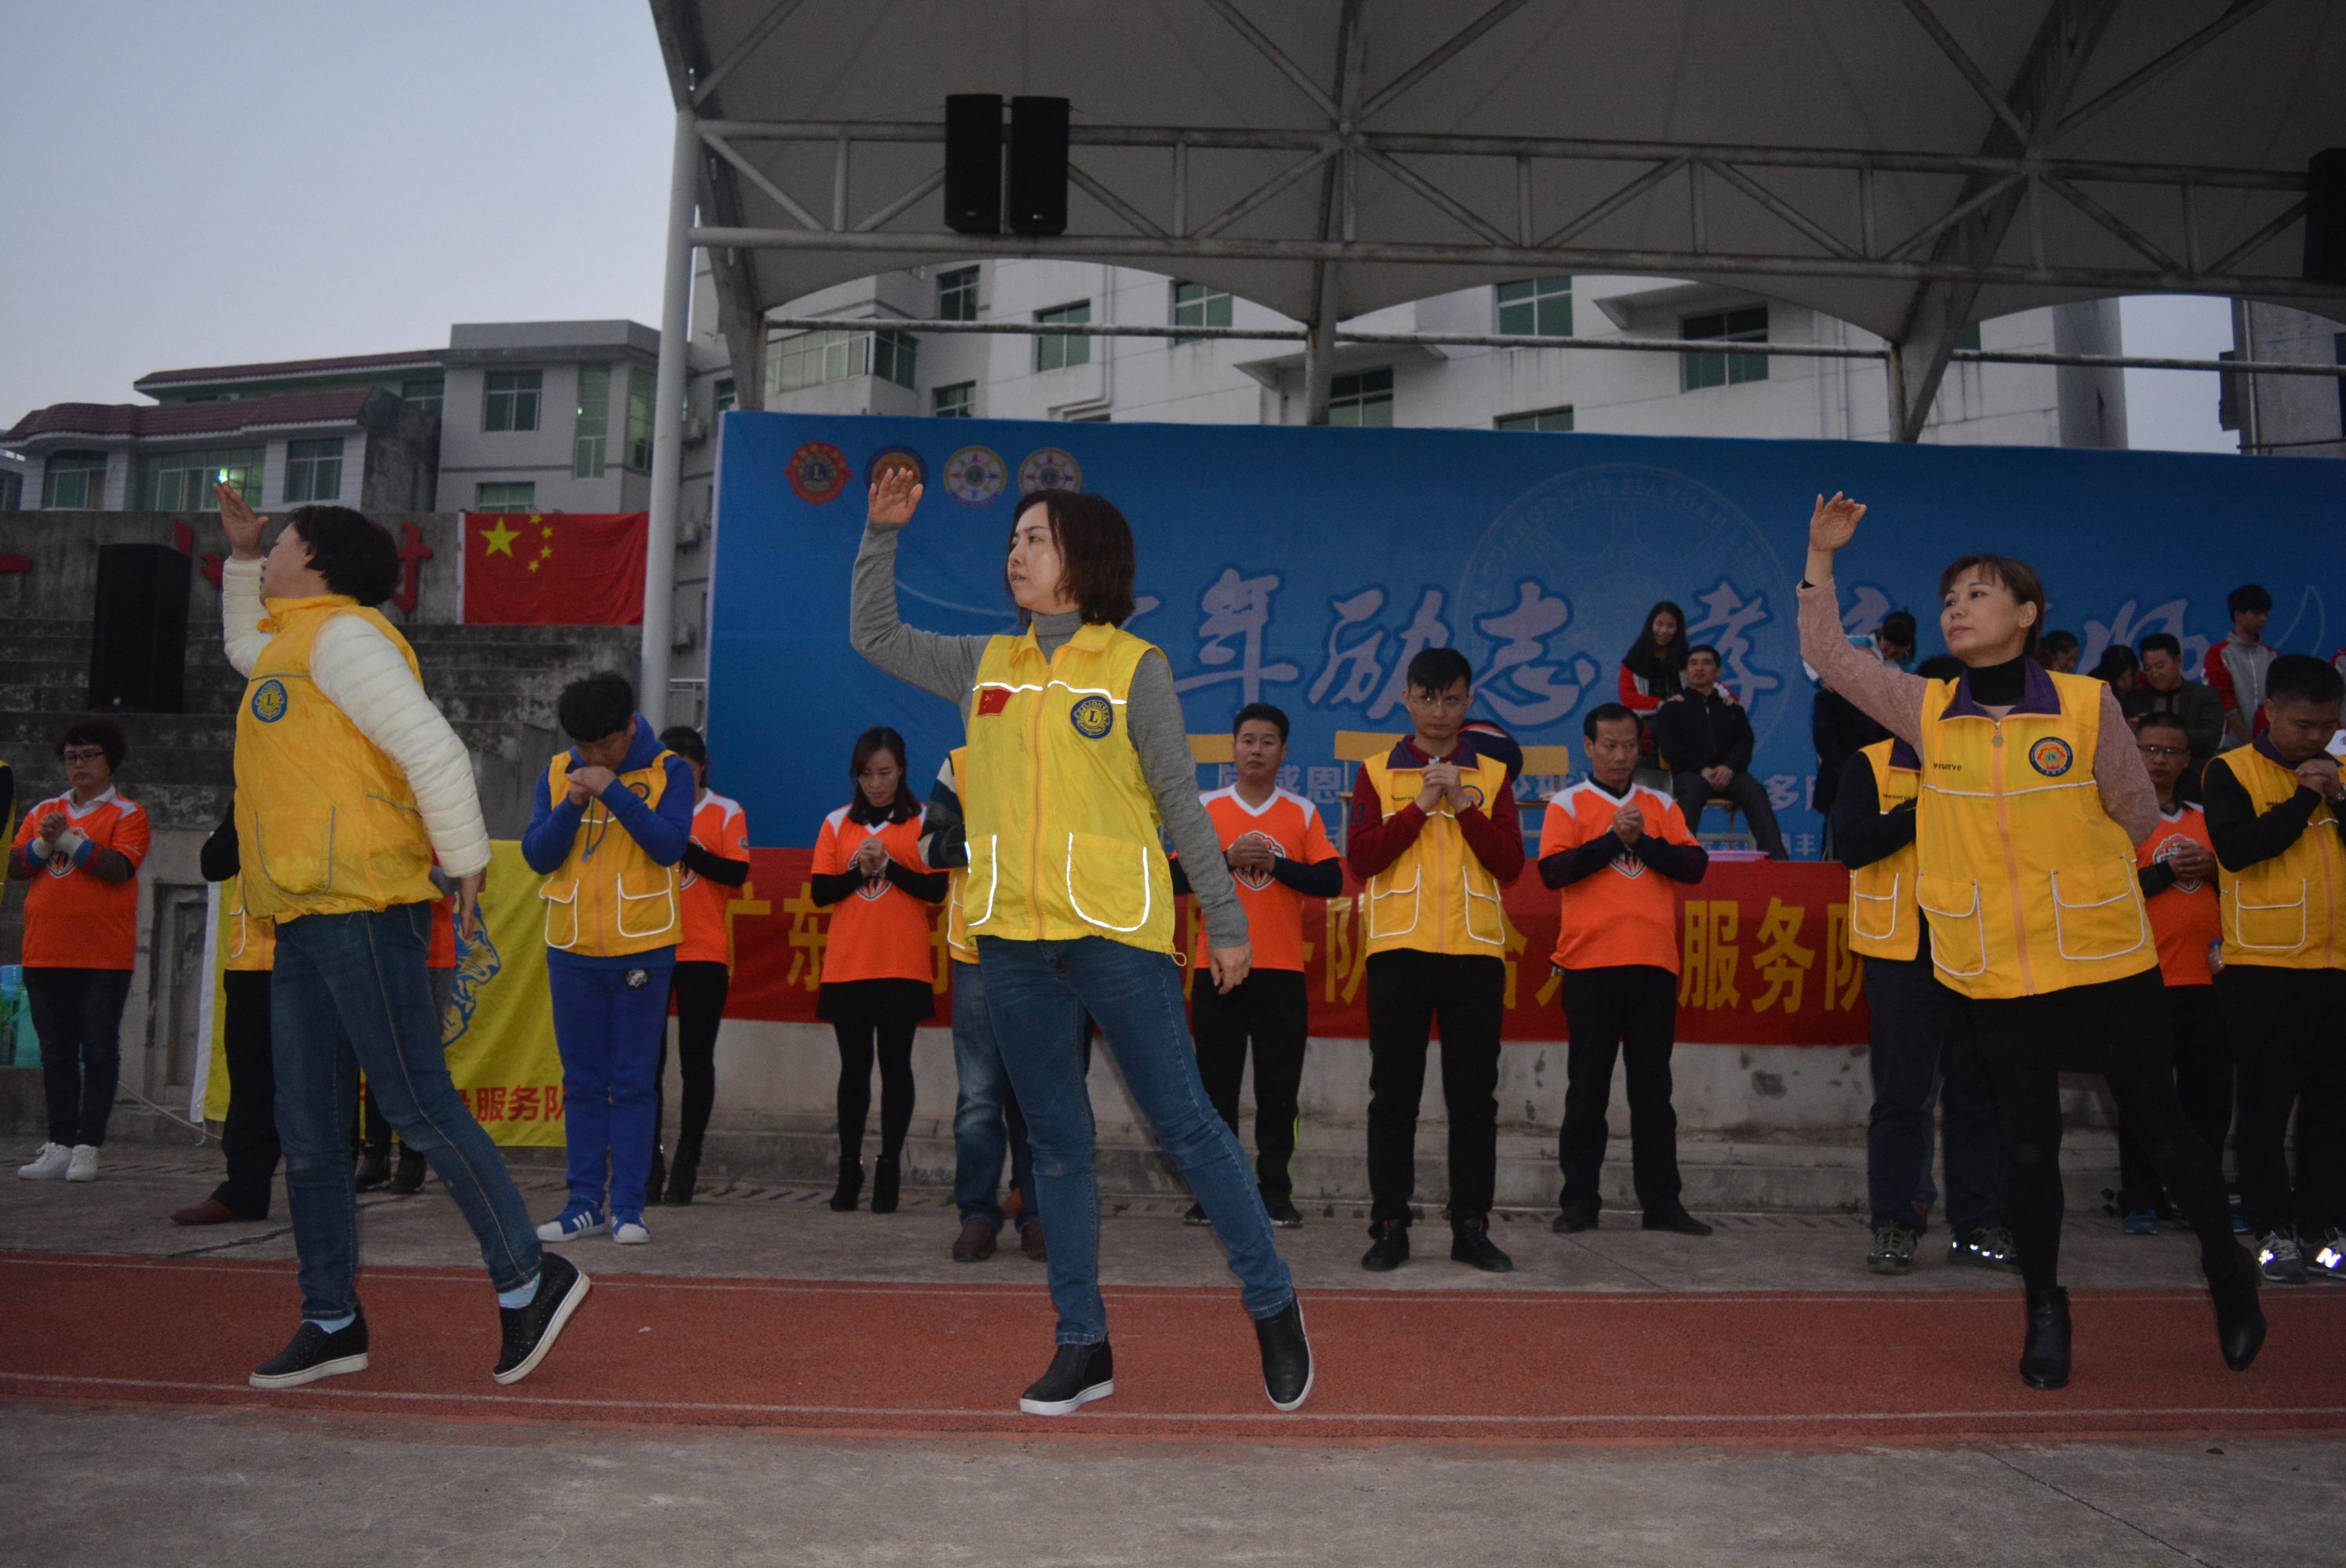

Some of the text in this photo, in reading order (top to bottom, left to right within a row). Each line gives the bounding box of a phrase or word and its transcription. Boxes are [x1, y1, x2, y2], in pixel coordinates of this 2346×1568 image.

[1088, 710, 1099, 723] L
[459, 1084, 568, 1123] 服务队
